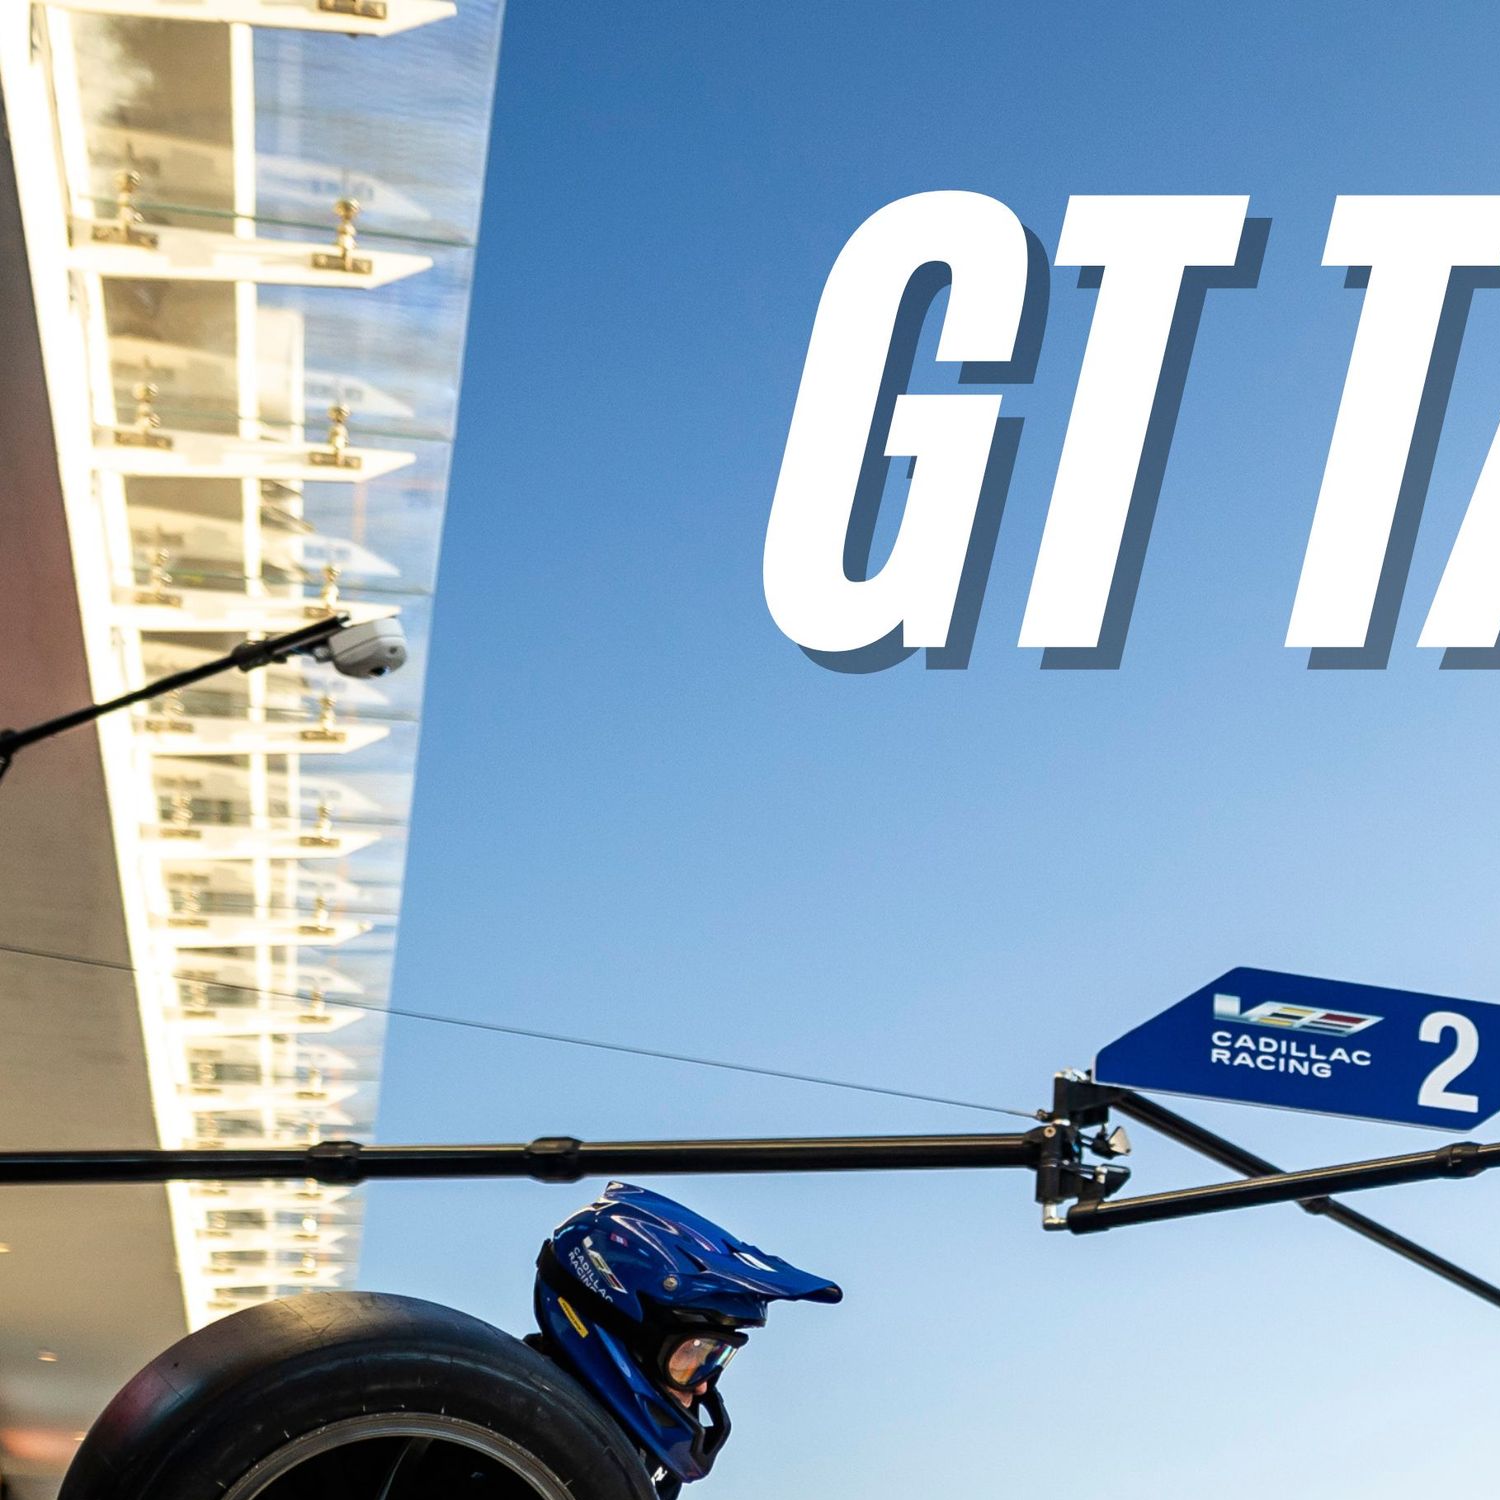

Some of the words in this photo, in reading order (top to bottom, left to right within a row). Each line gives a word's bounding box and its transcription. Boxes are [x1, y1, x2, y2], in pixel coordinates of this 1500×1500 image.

[1211, 1031, 1372, 1066] CADILLAC
[1211, 1048, 1332, 1078] RACING
[1417, 1011, 1480, 1114] 2
